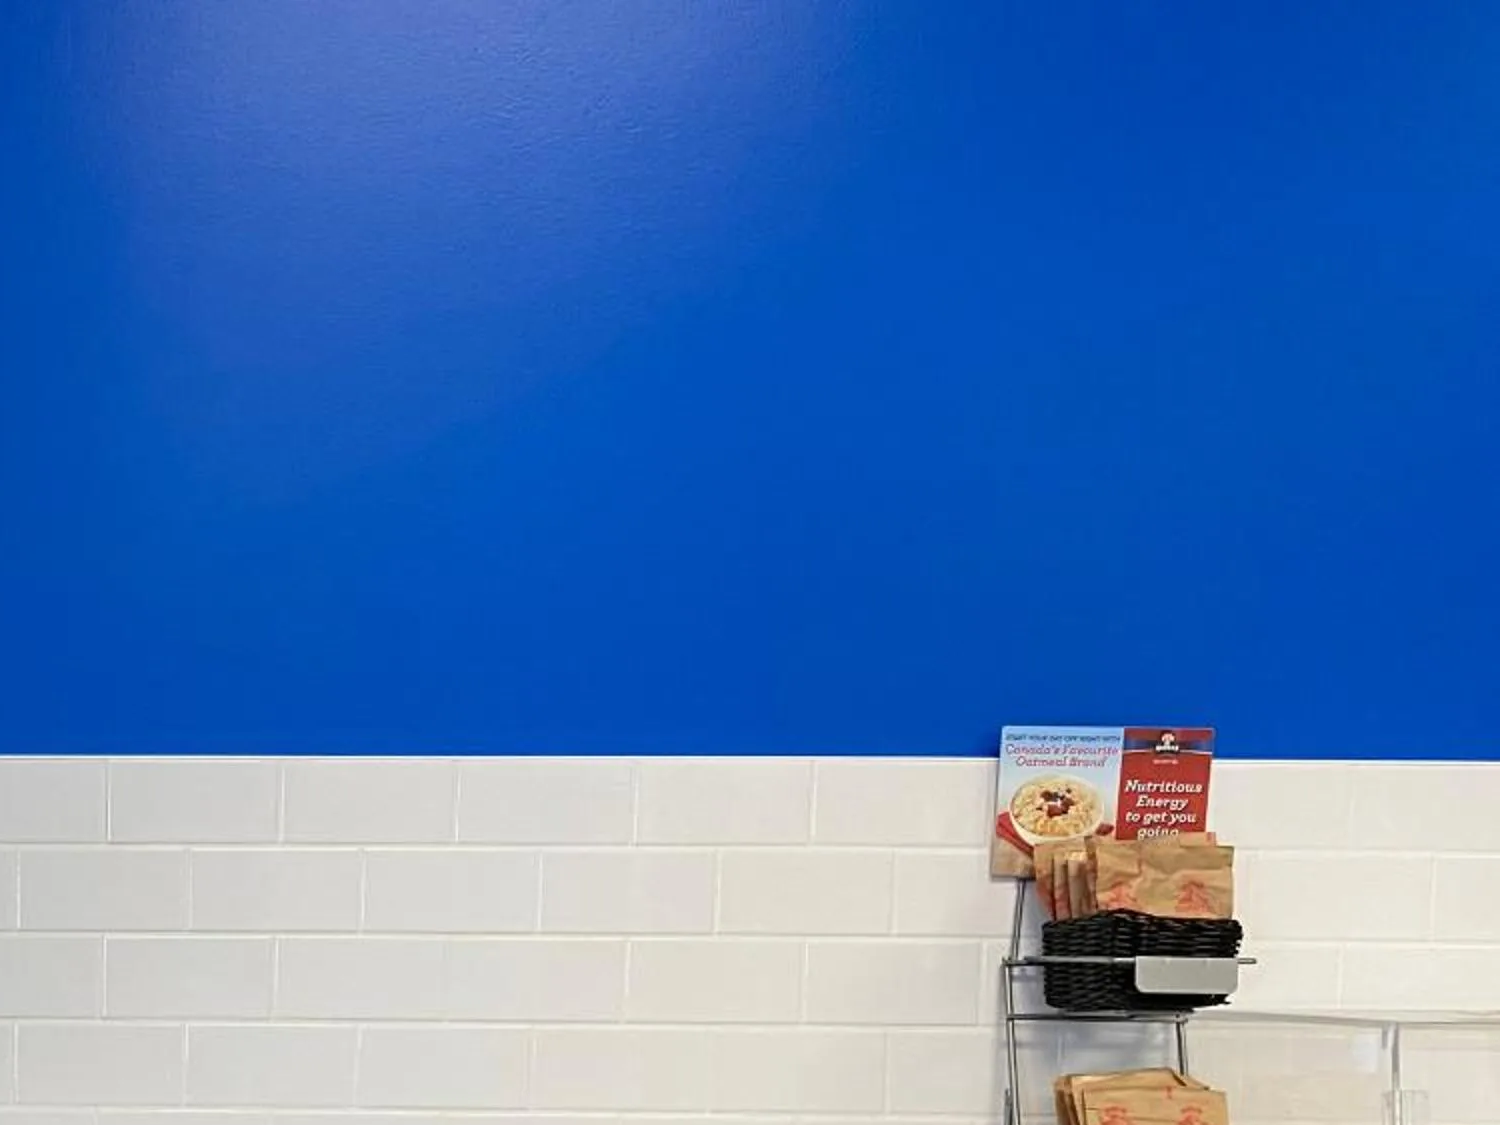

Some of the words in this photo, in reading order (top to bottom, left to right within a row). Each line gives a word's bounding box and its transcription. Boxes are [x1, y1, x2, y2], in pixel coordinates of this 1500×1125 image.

[1015, 756, 1068, 767] Oatmeal
[1124, 779, 1203, 793] Nutritious
[1136, 794, 1190, 811] Energy
[1125, 811, 1141, 823] to
[1143, 811, 1169, 825] get
[1167, 812, 1197, 826] you
